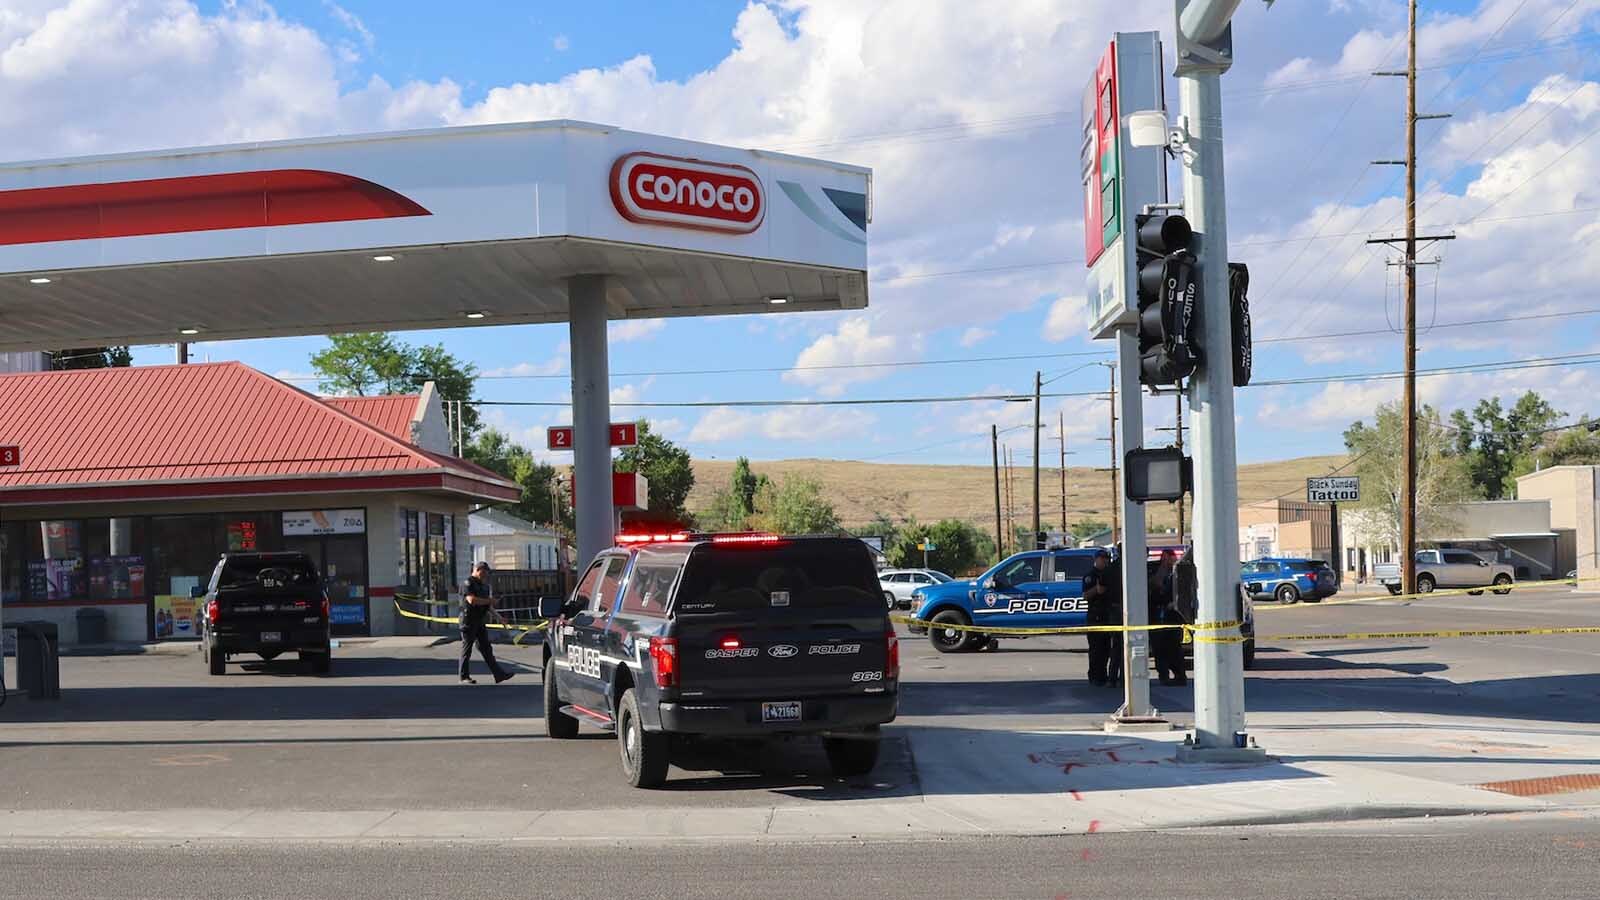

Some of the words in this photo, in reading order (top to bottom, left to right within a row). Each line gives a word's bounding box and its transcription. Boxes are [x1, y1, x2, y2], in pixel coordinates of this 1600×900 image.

[635, 173, 755, 214] CONOCO
[556, 431, 565, 445] 2
[619, 429, 626, 441] 1
[4, 450, 13, 462] 3
[1309, 479, 1329, 489] Black
[1330, 479, 1357, 490] Sunday
[1309, 490, 1358, 500] Tattoo
[1007, 597, 1089, 614] POLICE
[705, 647, 760, 659] CASPER
[808, 644, 861, 655] POLICE
[567, 644, 601, 680] POLICE
[851, 671, 882, 682] 364
